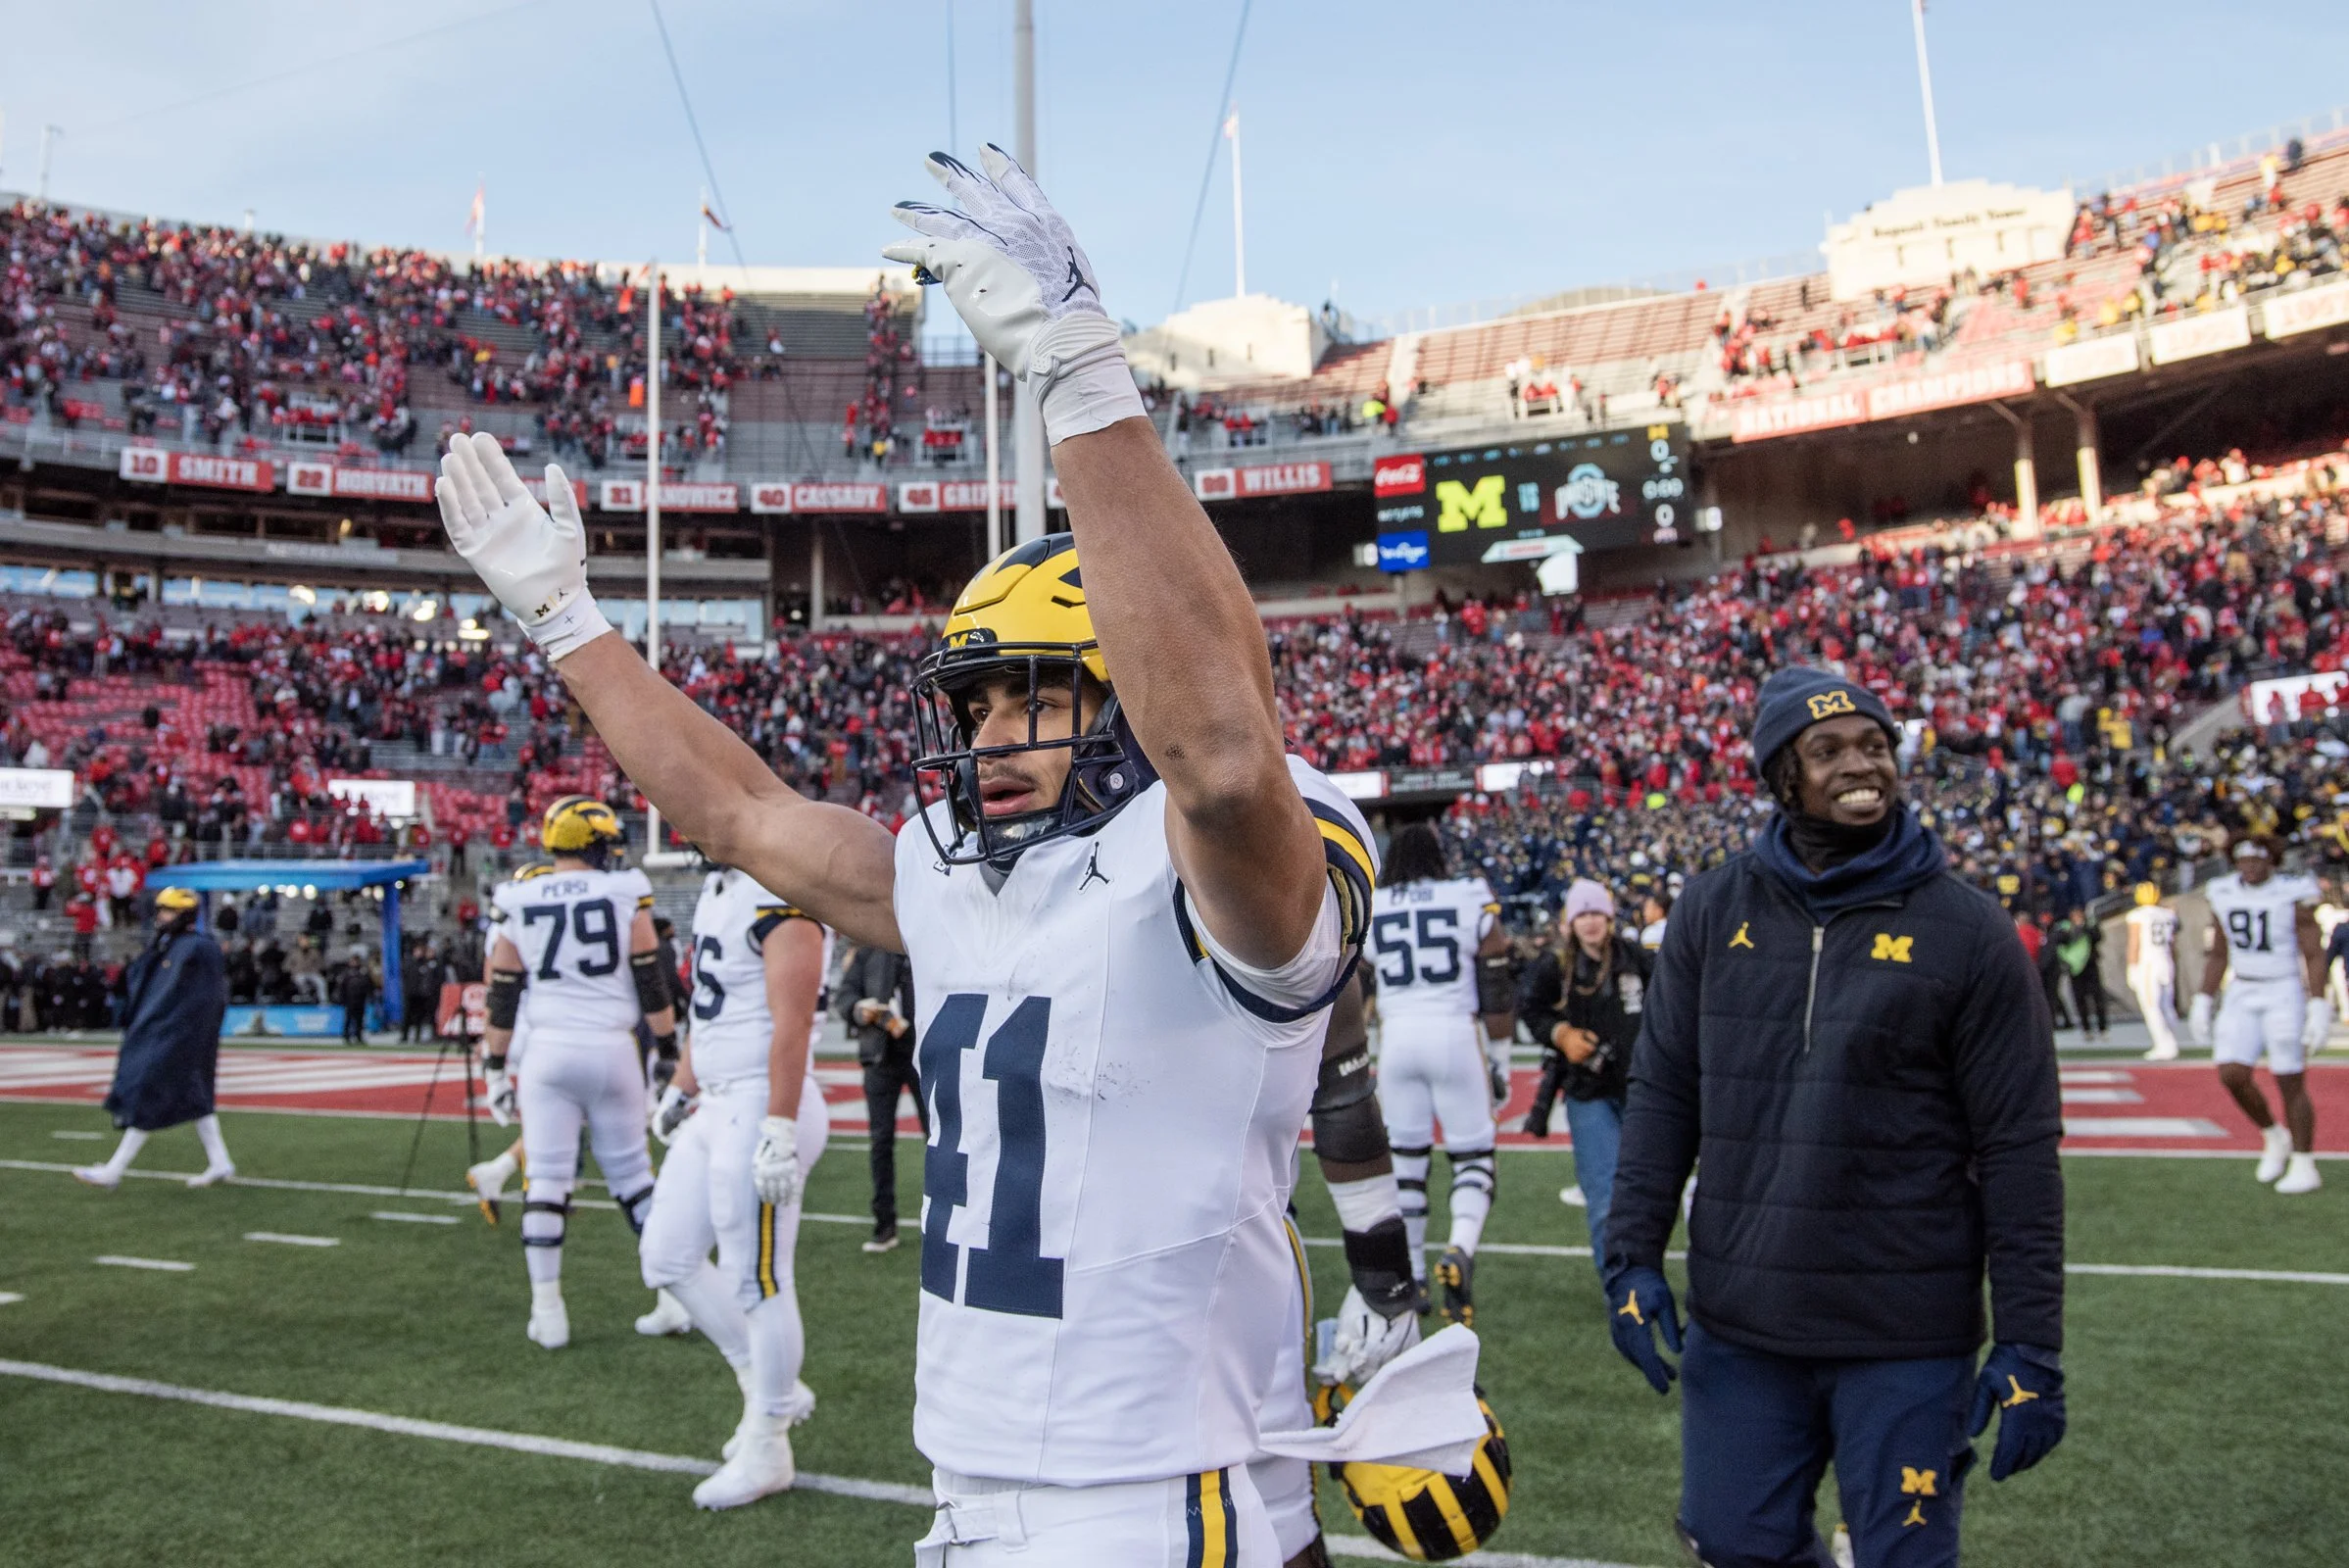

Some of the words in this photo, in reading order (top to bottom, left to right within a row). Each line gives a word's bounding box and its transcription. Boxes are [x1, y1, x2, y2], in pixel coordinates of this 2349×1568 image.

[1739, 393, 1860, 431] NATIONAL
[1871, 363, 2027, 410] CHAMPIONS
[178, 456, 258, 486] SMITH
[1243, 464, 1321, 492] WILLIS
[1436, 474, 1508, 532] M
[535, 603, 551, 618] M
[1807, 690, 1856, 720] M
[523, 898, 619, 980] 79
[1373, 908, 1459, 987] 55
[1871, 933, 1914, 963] M
[2228, 909, 2272, 952] 91
[919, 993, 1064, 1320] 41
[1900, 1465, 1937, 1496] M
